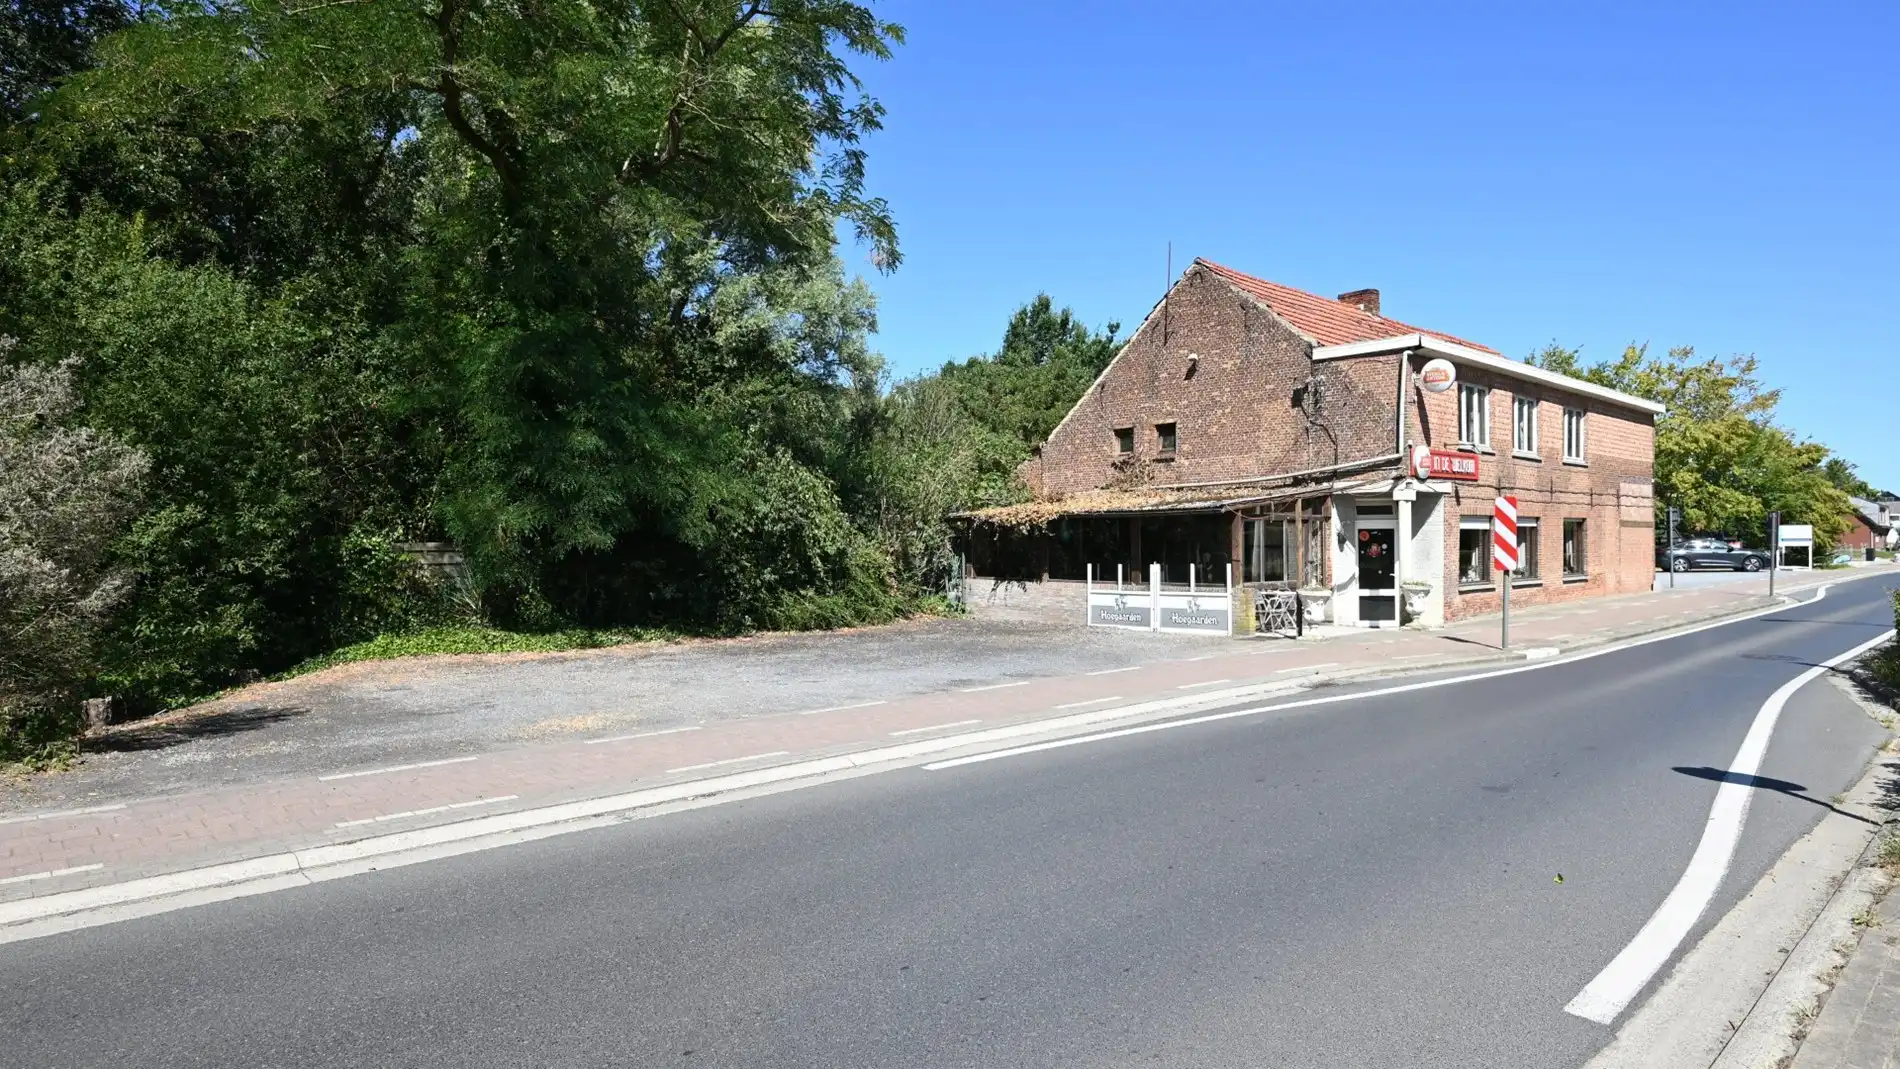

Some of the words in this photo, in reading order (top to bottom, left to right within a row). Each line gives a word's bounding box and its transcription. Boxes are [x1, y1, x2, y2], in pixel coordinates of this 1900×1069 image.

[1442, 457, 1450, 471] DE
[1100, 610, 1142, 623] Hoegaarden
[1171, 612, 1218, 626] Hoegaarden
